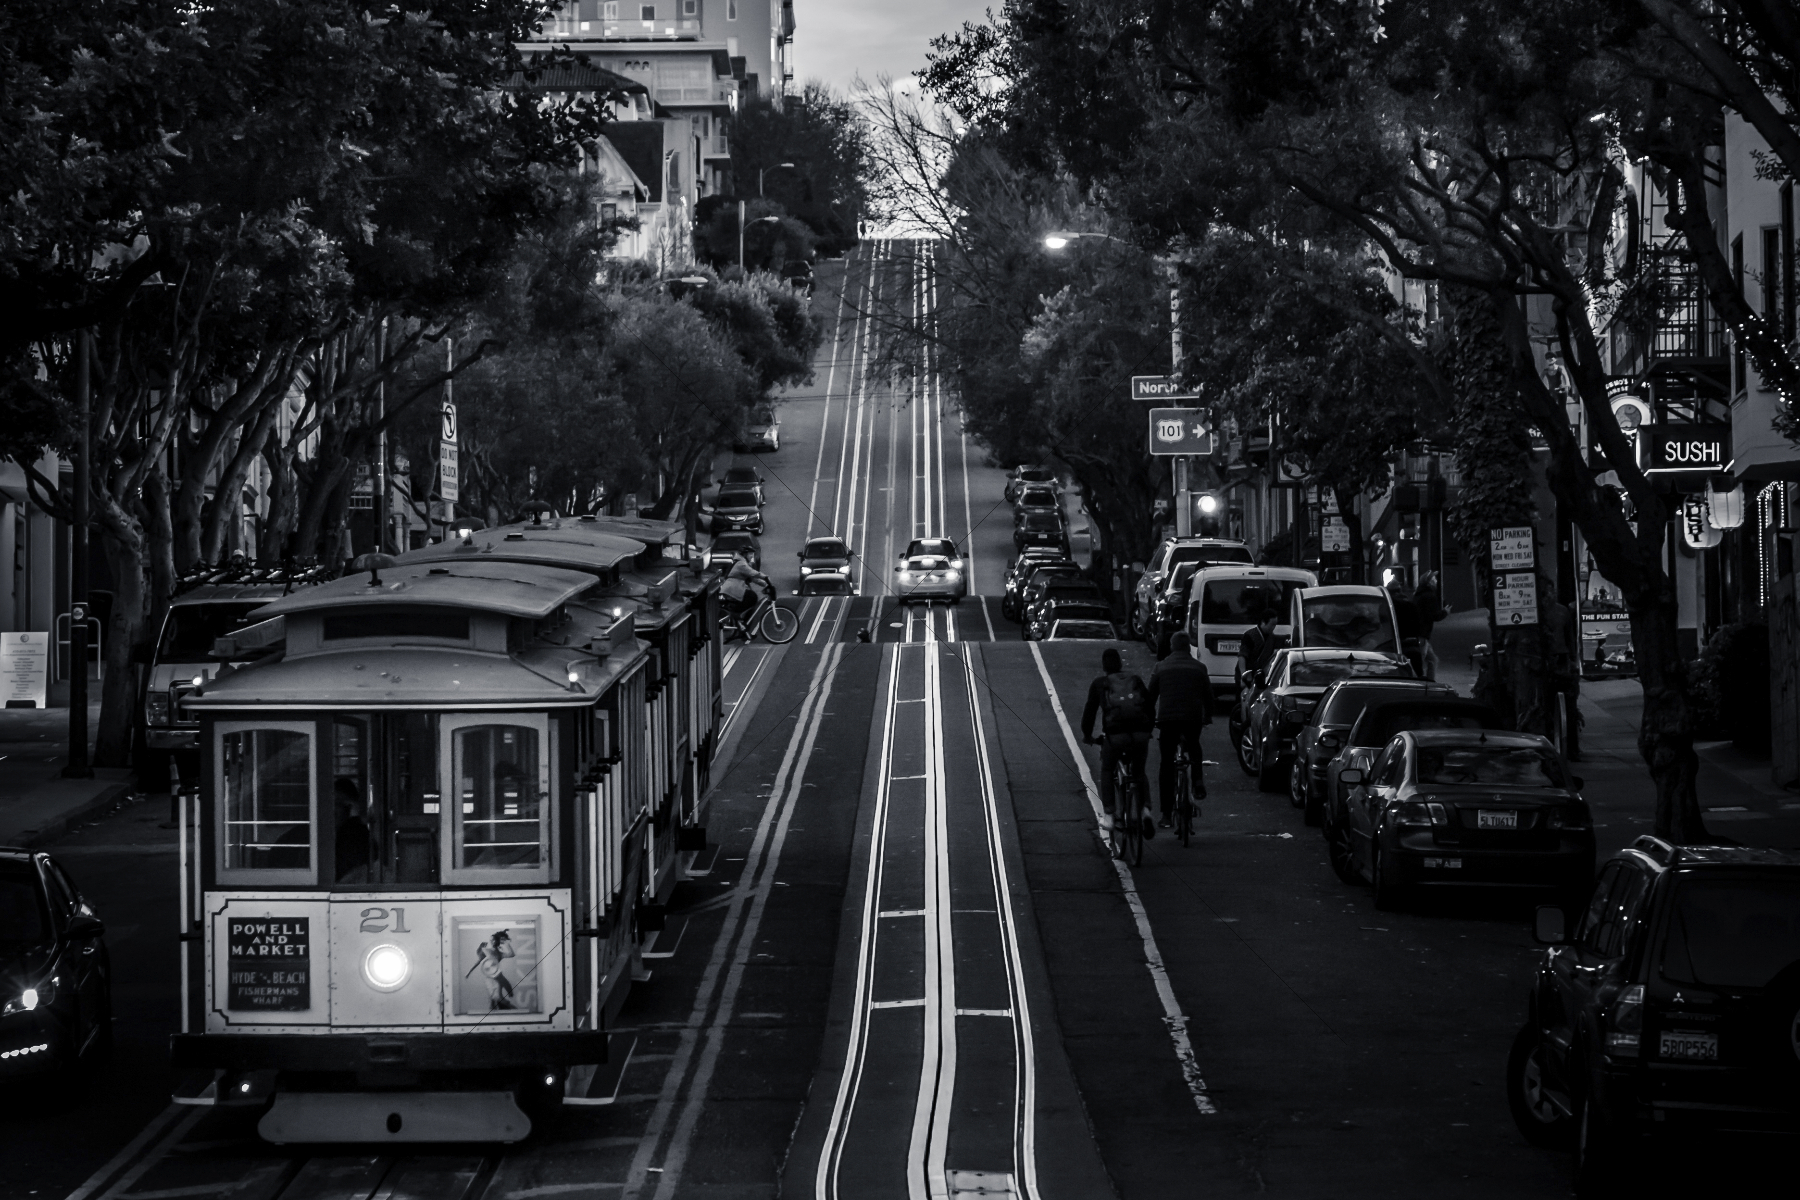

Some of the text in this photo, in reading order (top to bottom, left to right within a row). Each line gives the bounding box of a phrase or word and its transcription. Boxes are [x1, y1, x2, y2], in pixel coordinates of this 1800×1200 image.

[1162, 425, 1180, 437] 101
[1665, 441, 1720, 462] SUSHI
[1491, 528, 1531, 540] NO PARKING
[1514, 551, 1522, 560] FRI
[1523, 551, 1532, 560] SAT
[1496, 576, 1504, 588] 2
[360, 907, 411, 933] 21
[232, 924, 305, 935] POWELL
[252, 936, 288, 944] AND
[231, 945, 306, 956] MARKET
[231, 971, 257, 984] HYDE
[272, 971, 306, 984] BEACH
[238, 986, 299, 996] FISHERMANS
[252, 995, 285, 1005] WHARF
